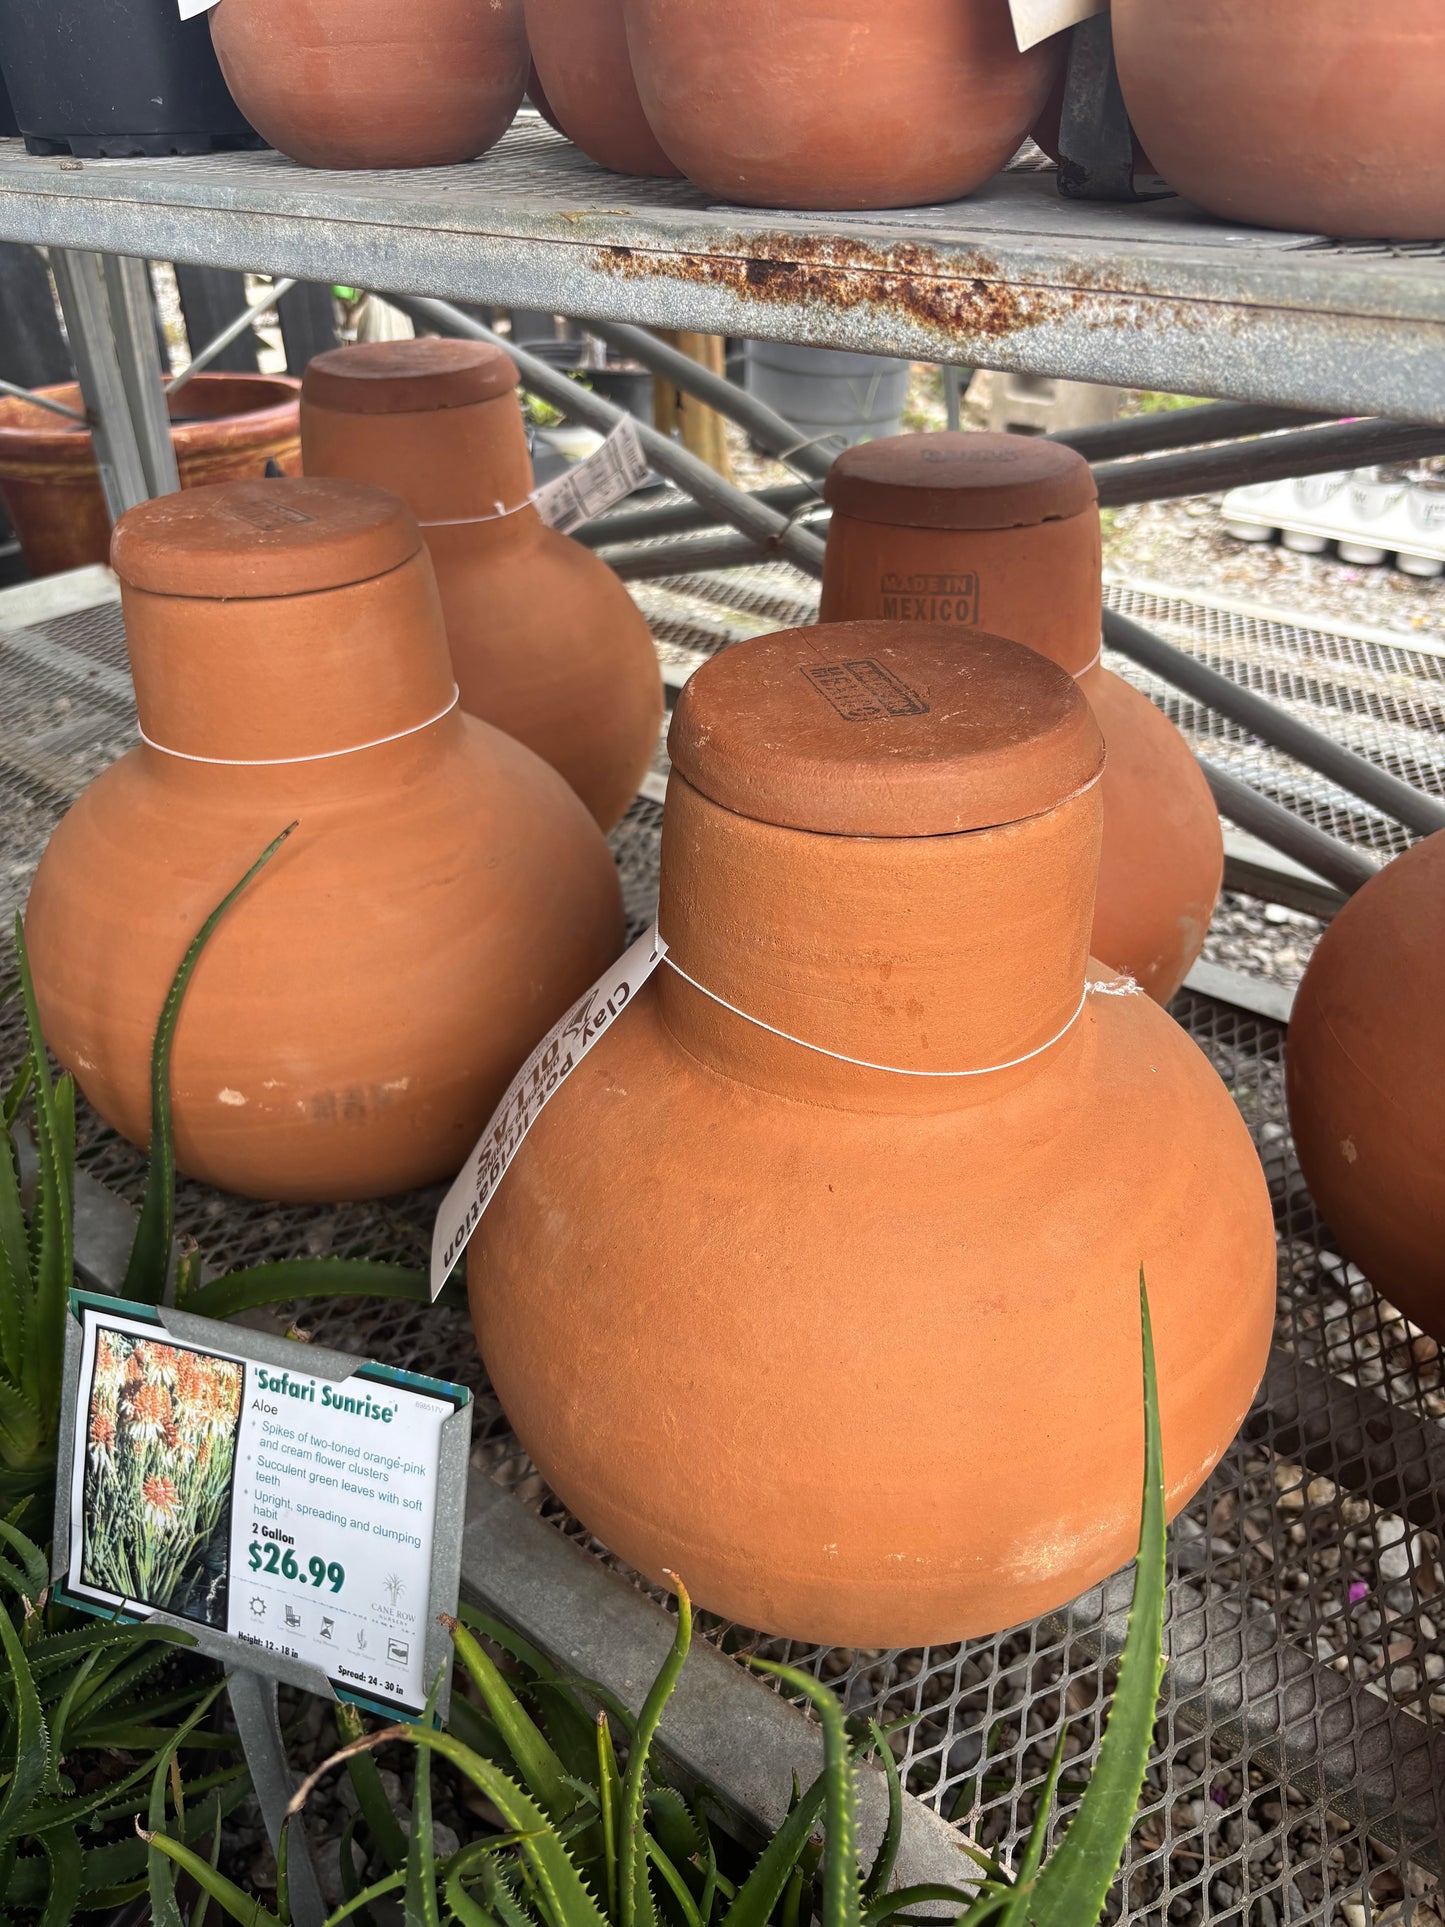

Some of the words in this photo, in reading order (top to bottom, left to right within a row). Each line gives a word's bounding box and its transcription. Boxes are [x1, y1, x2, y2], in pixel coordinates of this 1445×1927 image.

[944, 576, 967, 594] IN
[883, 598, 969, 622] MEXICO
[582, 981, 630, 1047] Clay
[537, 1051, 574, 1108] Pot
[477, 1038, 559, 1175] OLLAS
[443, 1111, 530, 1268] Irrigation
[251, 1398, 279, 1416] Aloe
[254, 1367, 316, 1403] 'Safari
[321, 1384, 398, 1424] Sunrise'
[259, 1437, 279, 1451] and
[281, 1443, 313, 1461] cream
[315, 1452, 346, 1470] flower
[348, 1462, 390, 1482] clusters
[262, 1420, 295, 1440] Spikes
[297, 1432, 309, 1443] of
[310, 1436, 361, 1458] two-toned
[363, 1450, 426, 1476] orange-pink
[255, 1470, 281, 1487] teeth
[257, 1454, 307, 1479] Succulent
[309, 1470, 339, 1489] green
[341, 1479, 375, 1498] leaves
[378, 1490, 400, 1505] with
[402, 1498, 424, 1512] soft
[252, 1522, 259, 1534] 2
[262, 1526, 295, 1545] Gallon
[253, 1504, 279, 1521] habit
[254, 1489, 294, 1512] Upright,
[296, 1503, 347, 1527] spreading
[350, 1518, 371, 1533] and
[372, 1526, 421, 1548] clumping
[248, 1540, 345, 1594] $26.99
[371, 1601, 395, 1617] CANE
[396, 1609, 417, 1623] ROW
[238, 1630, 264, 1647] Height:
[265, 1640, 274, 1651] 12
[281, 1645, 291, 1656] 18
[291, 1648, 299, 1659] in
[337, 1664, 367, 1682] Spread:
[368, 1675, 378, 1687] 24
[384, 1681, 395, 1692] 30
[396, 1684, 404, 1695] in
